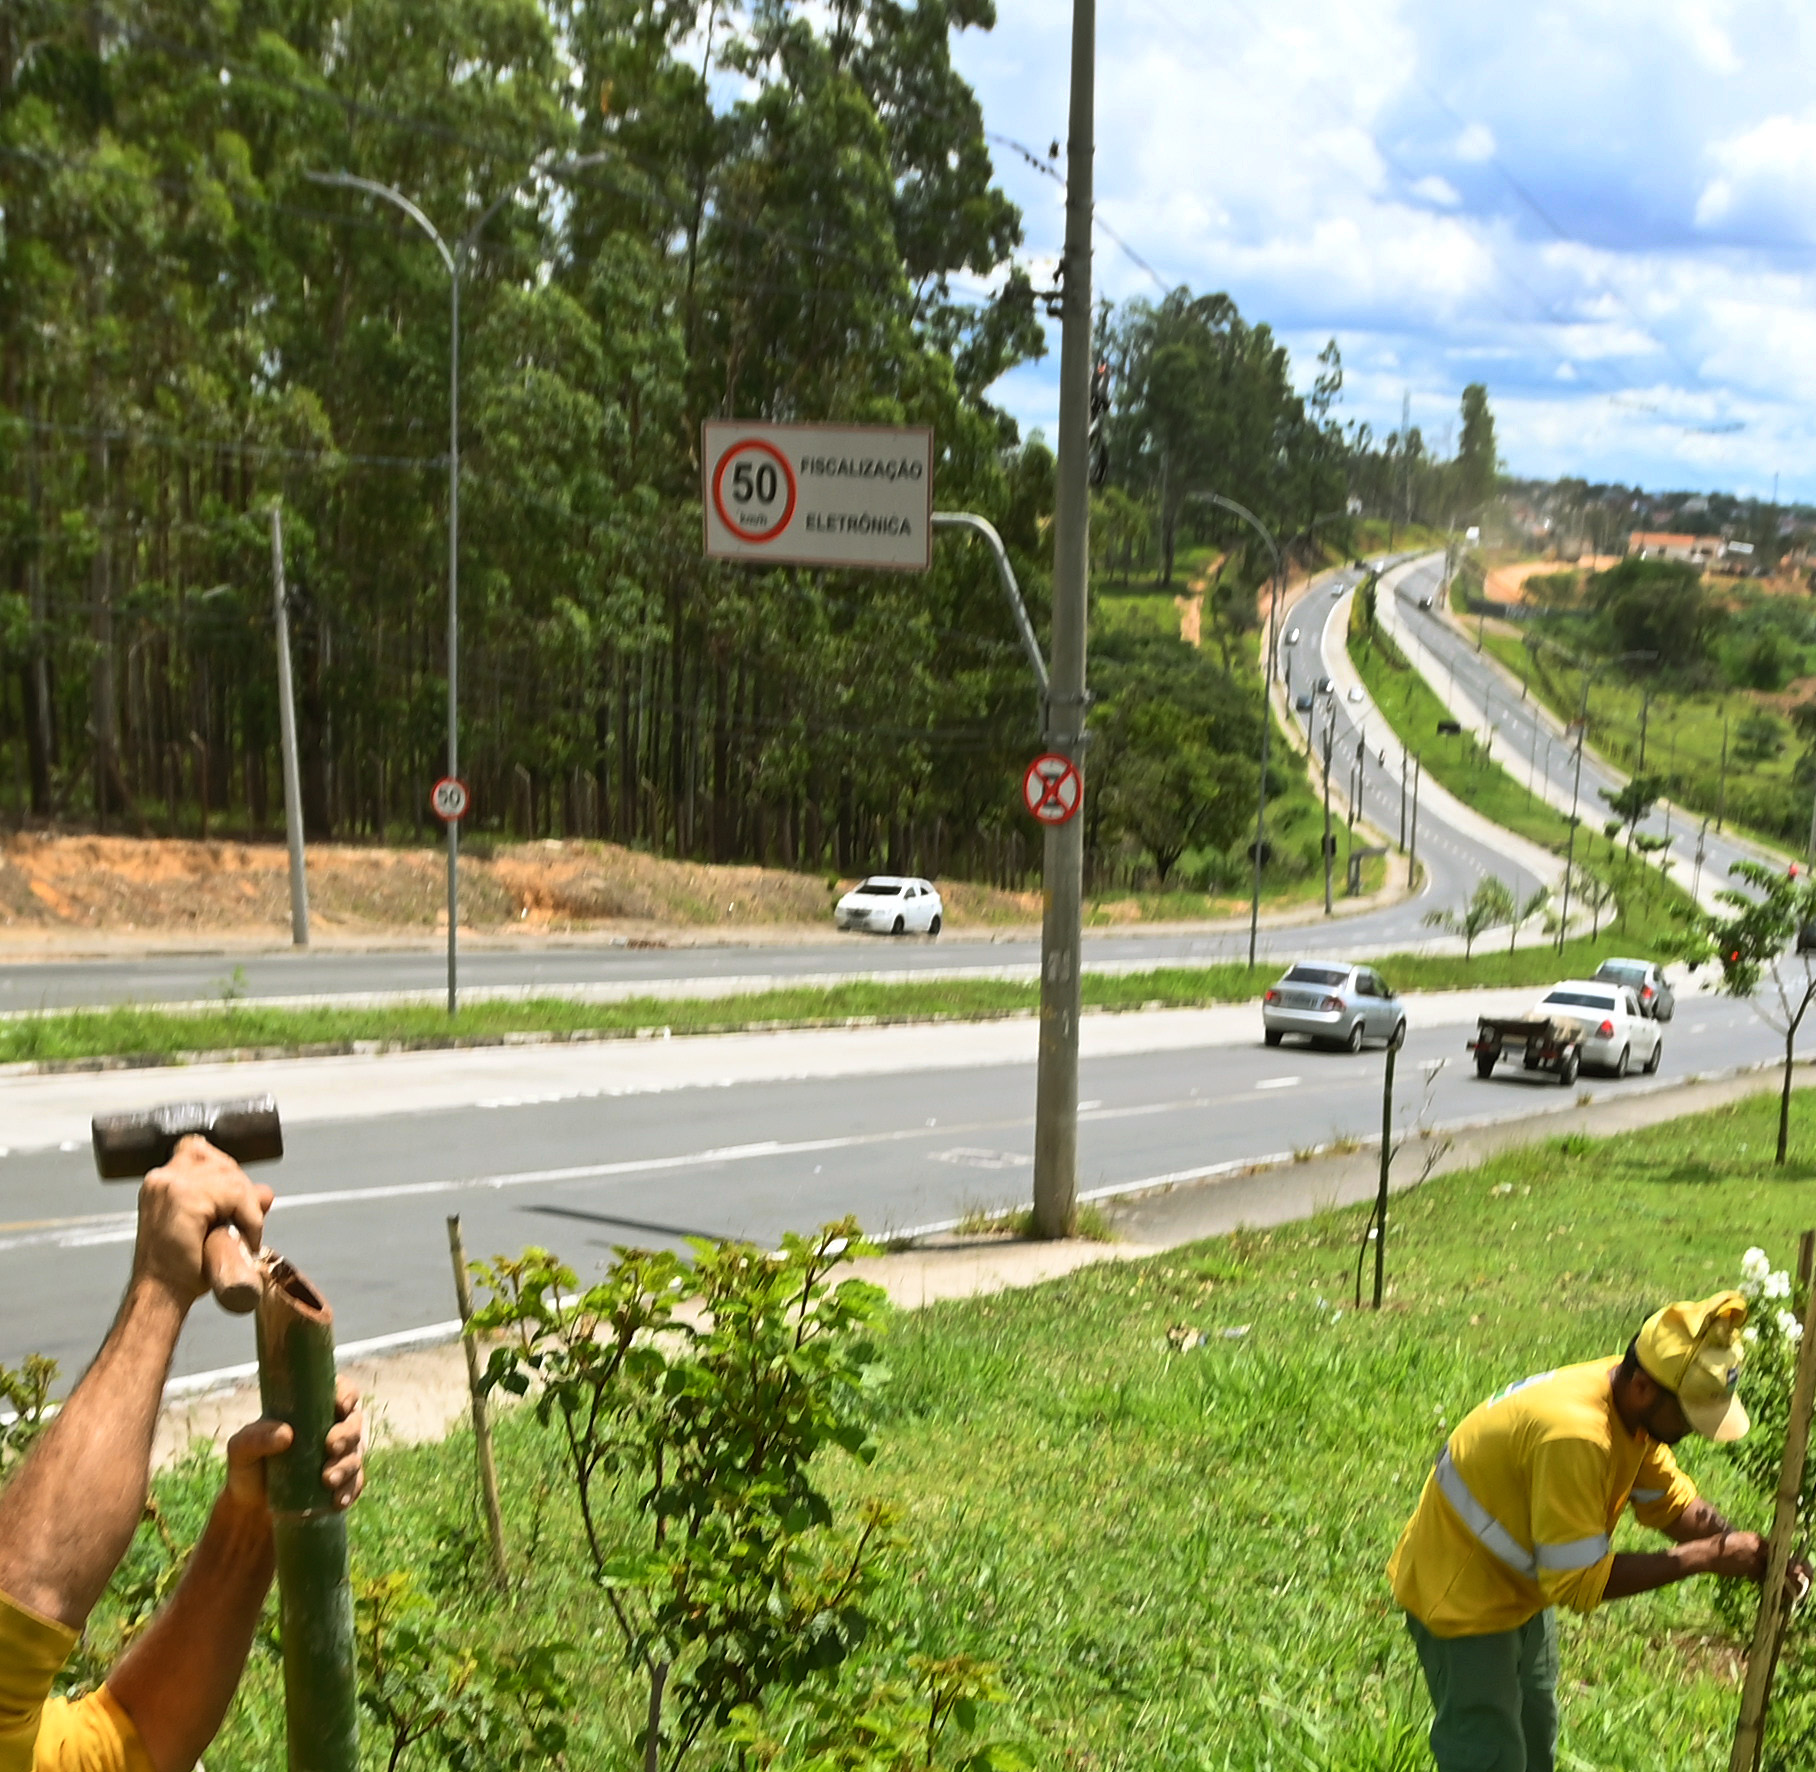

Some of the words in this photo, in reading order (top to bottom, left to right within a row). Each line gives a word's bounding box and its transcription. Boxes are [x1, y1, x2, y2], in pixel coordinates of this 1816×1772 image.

[732, 462, 777, 504] 50
[800, 455, 923, 483] FISCALIZAÇÃO
[805, 510, 912, 537] ELETRÔNICA
